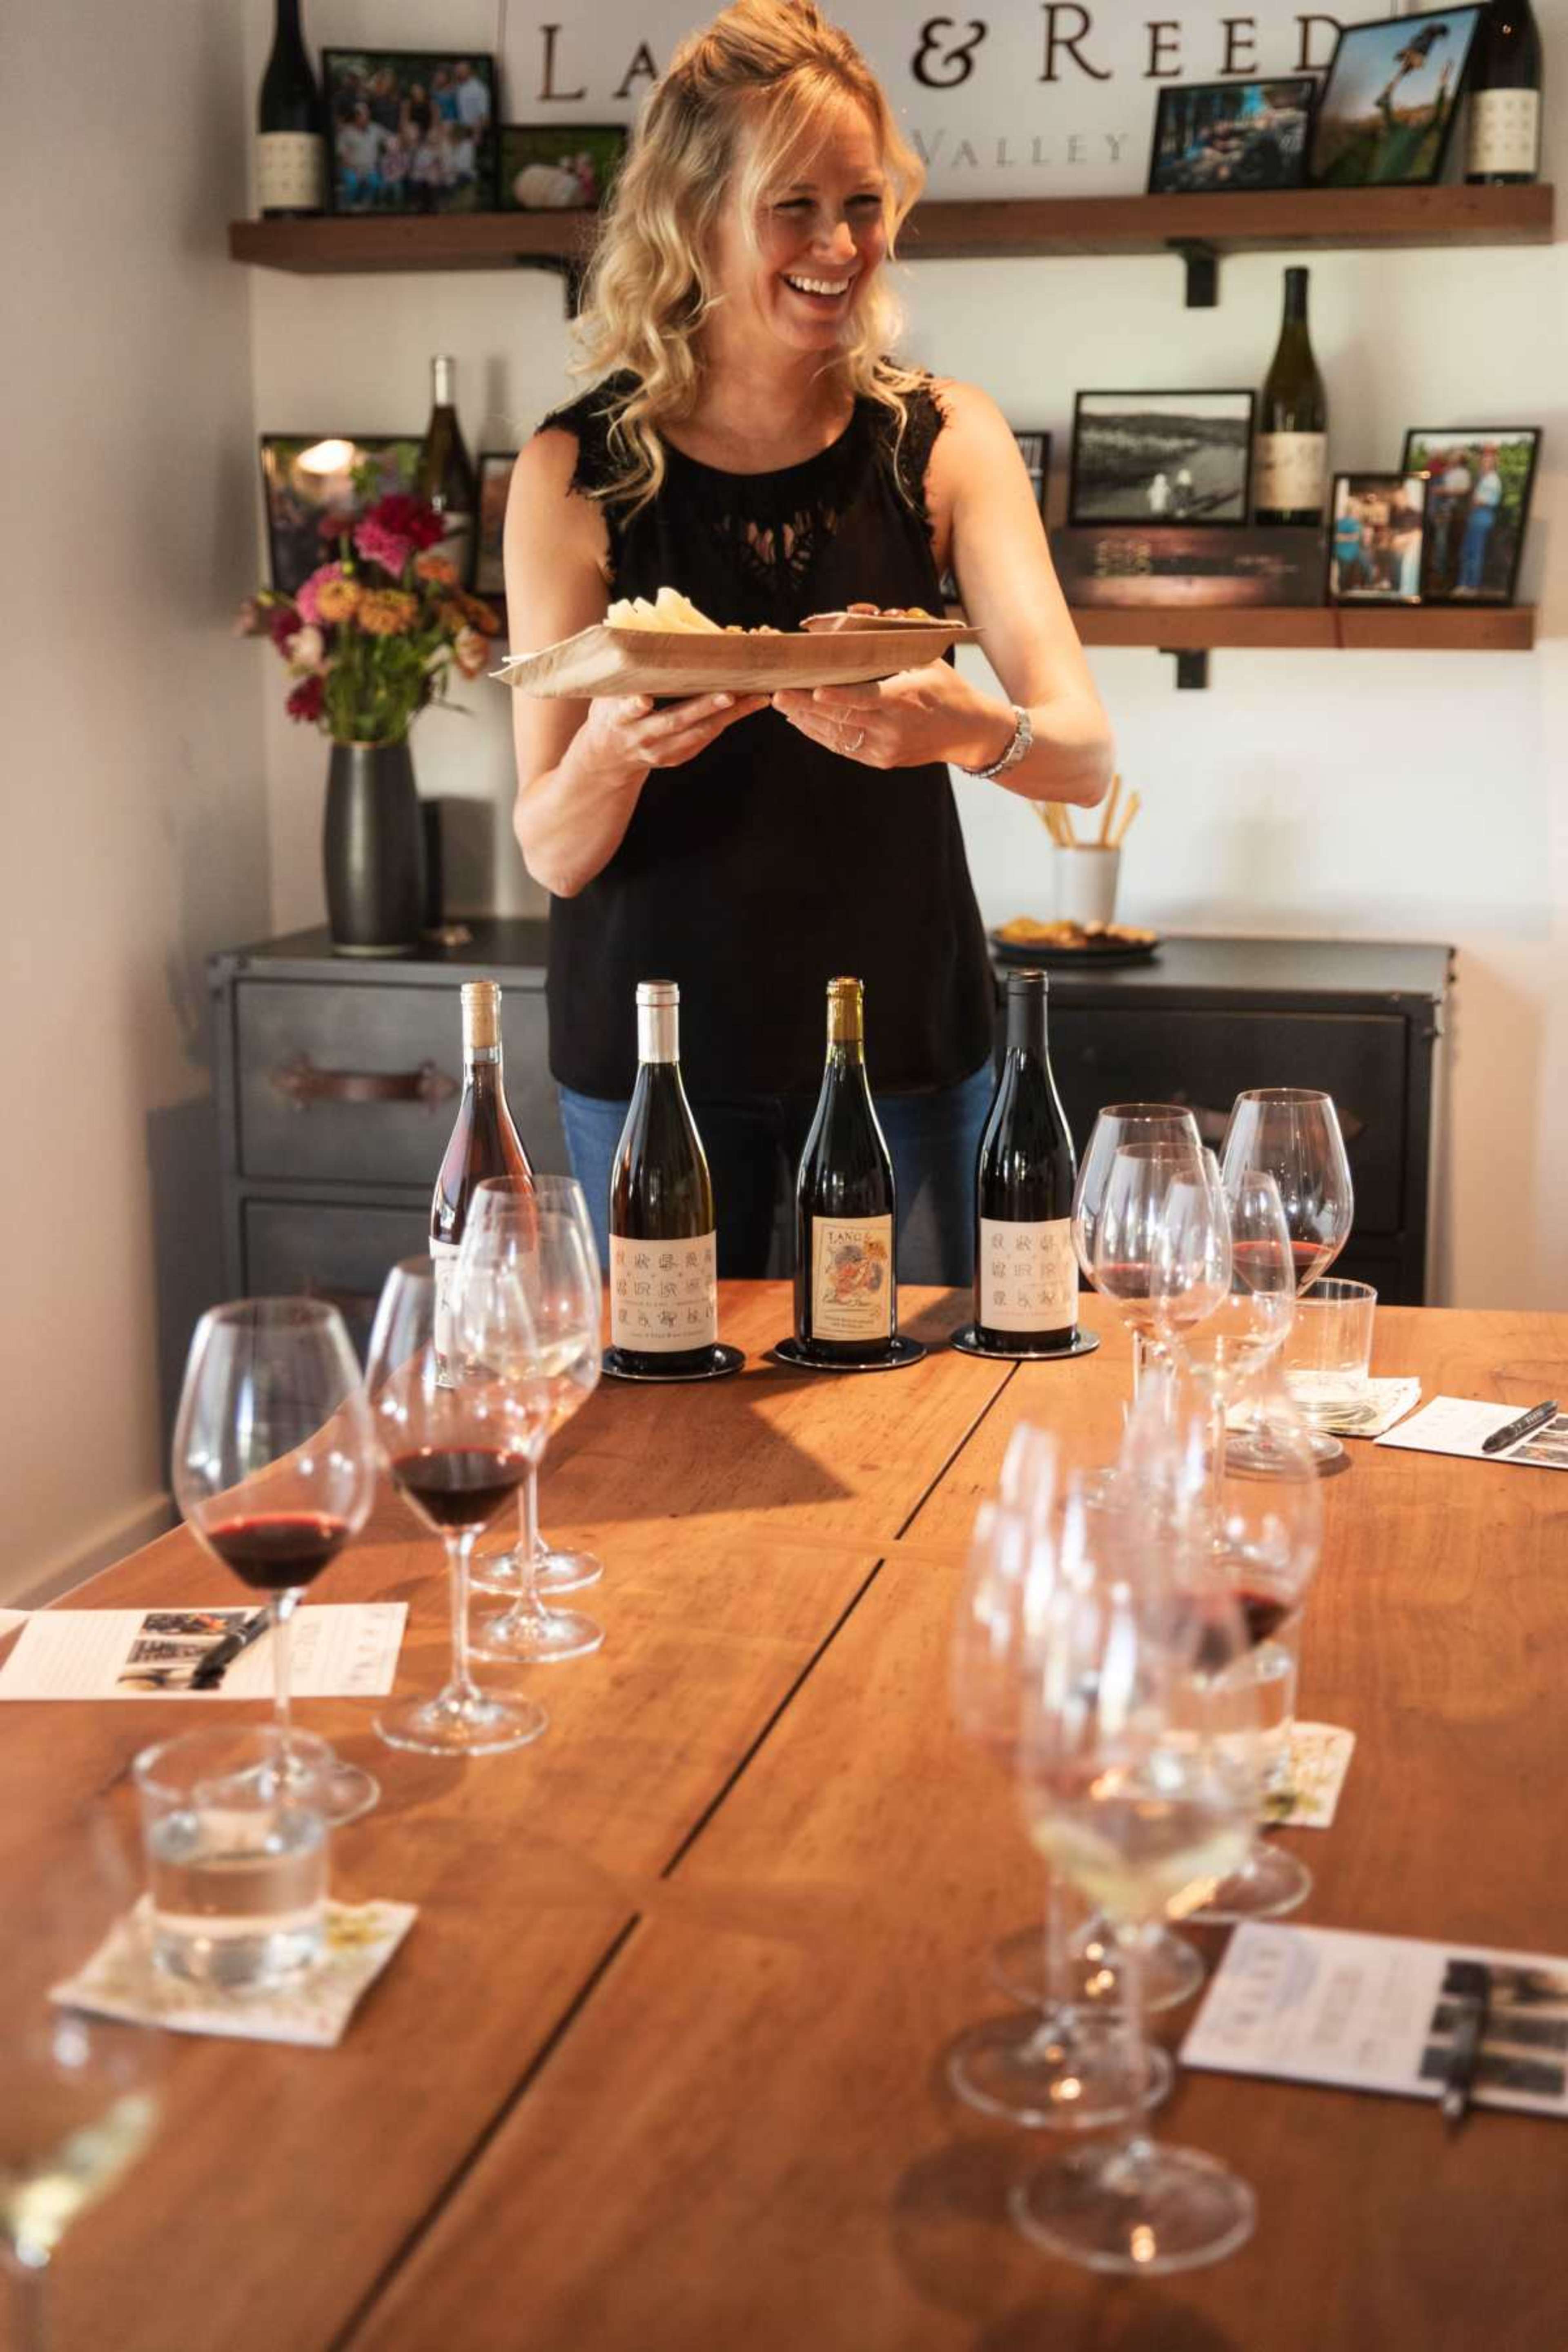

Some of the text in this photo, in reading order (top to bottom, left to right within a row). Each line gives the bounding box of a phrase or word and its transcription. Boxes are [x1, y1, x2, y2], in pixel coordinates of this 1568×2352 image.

[912, 17, 987, 88] &
[1039, 2, 1339, 82] REED
[910, 128, 1128, 167] VALLEY
